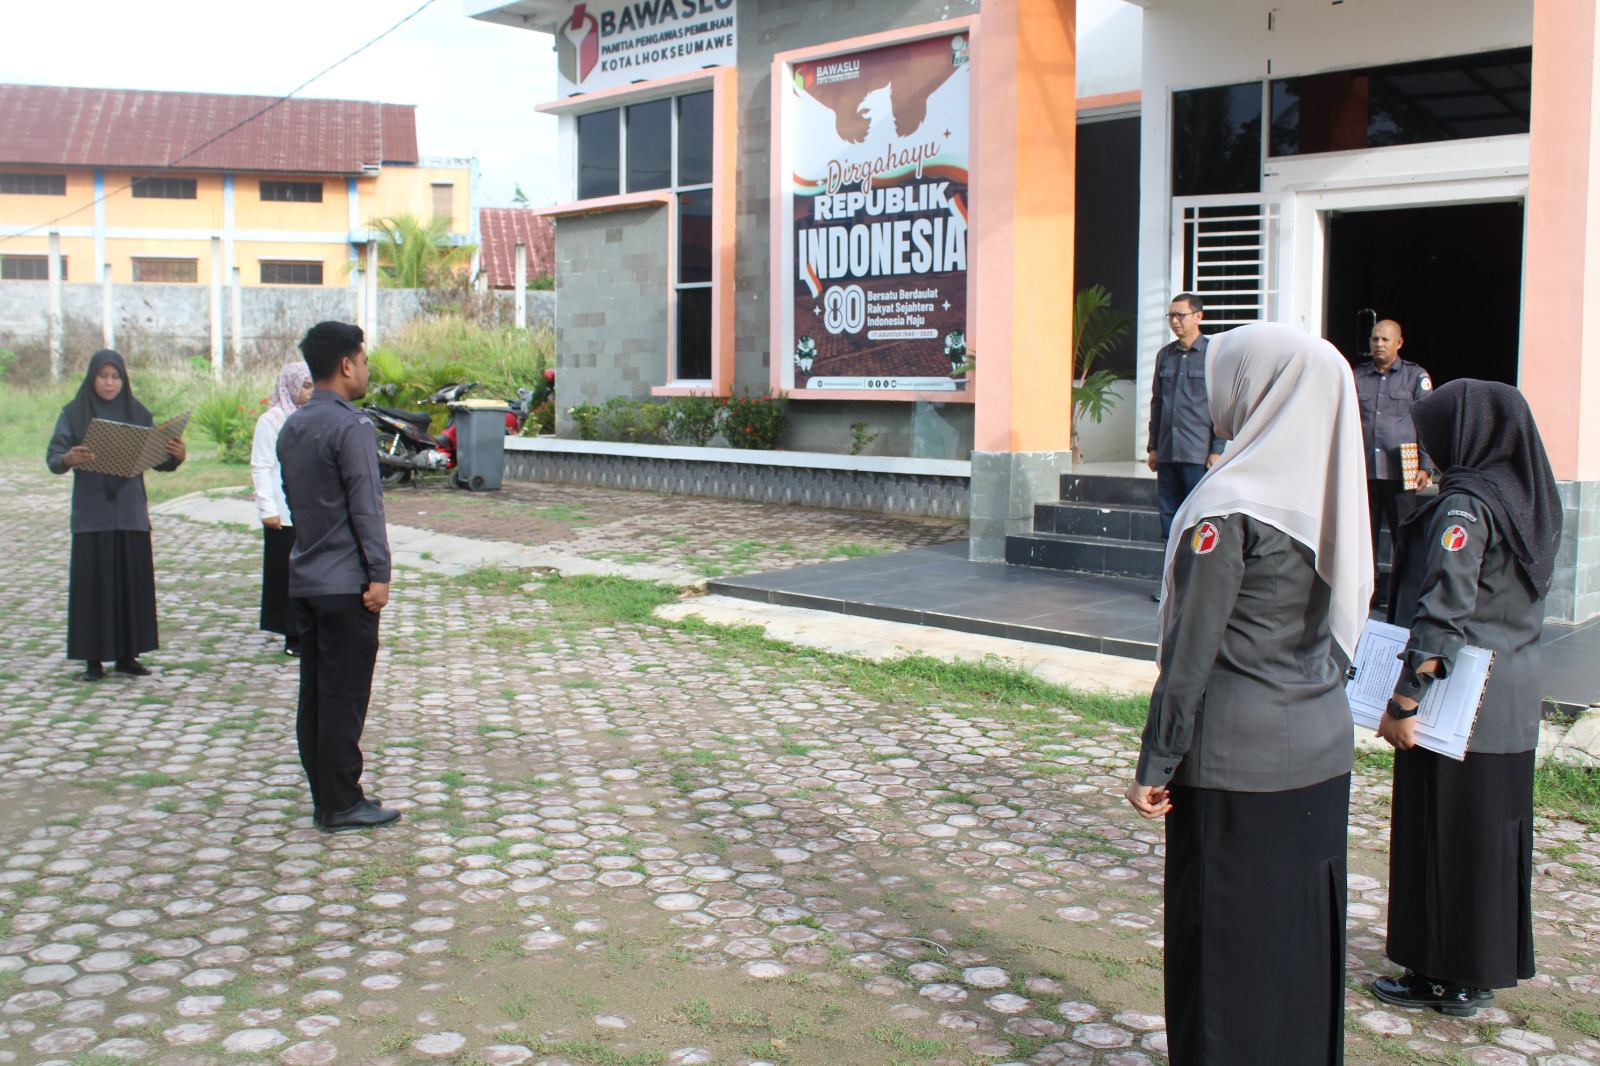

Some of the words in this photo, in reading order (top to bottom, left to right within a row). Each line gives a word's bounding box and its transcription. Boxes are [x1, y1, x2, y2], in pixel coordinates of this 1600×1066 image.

[601, 39, 634, 56] PANITIA
[635, 28, 684, 48] PENGAWAS
[684, 16, 733, 37] PEMILIHAN
[601, 55, 632, 72] KOTA
[635, 33, 733, 66] LHOKSEUMAWE
[816, 59, 860, 77] BAWASLU
[827, 141, 941, 195] Dirgahayu
[814, 181, 950, 221] REPUBLIK
[798, 216, 967, 280] INDONESIA
[824, 284, 866, 335] 80
[867, 291, 898, 301] Bersatu
[899, 288, 938, 300] Berdaulat
[867, 303, 894, 316] Rakyat
[895, 302, 934, 315] Sejahtera
[867, 315, 905, 327] Indonesia
[906, 314, 925, 327] Maju
